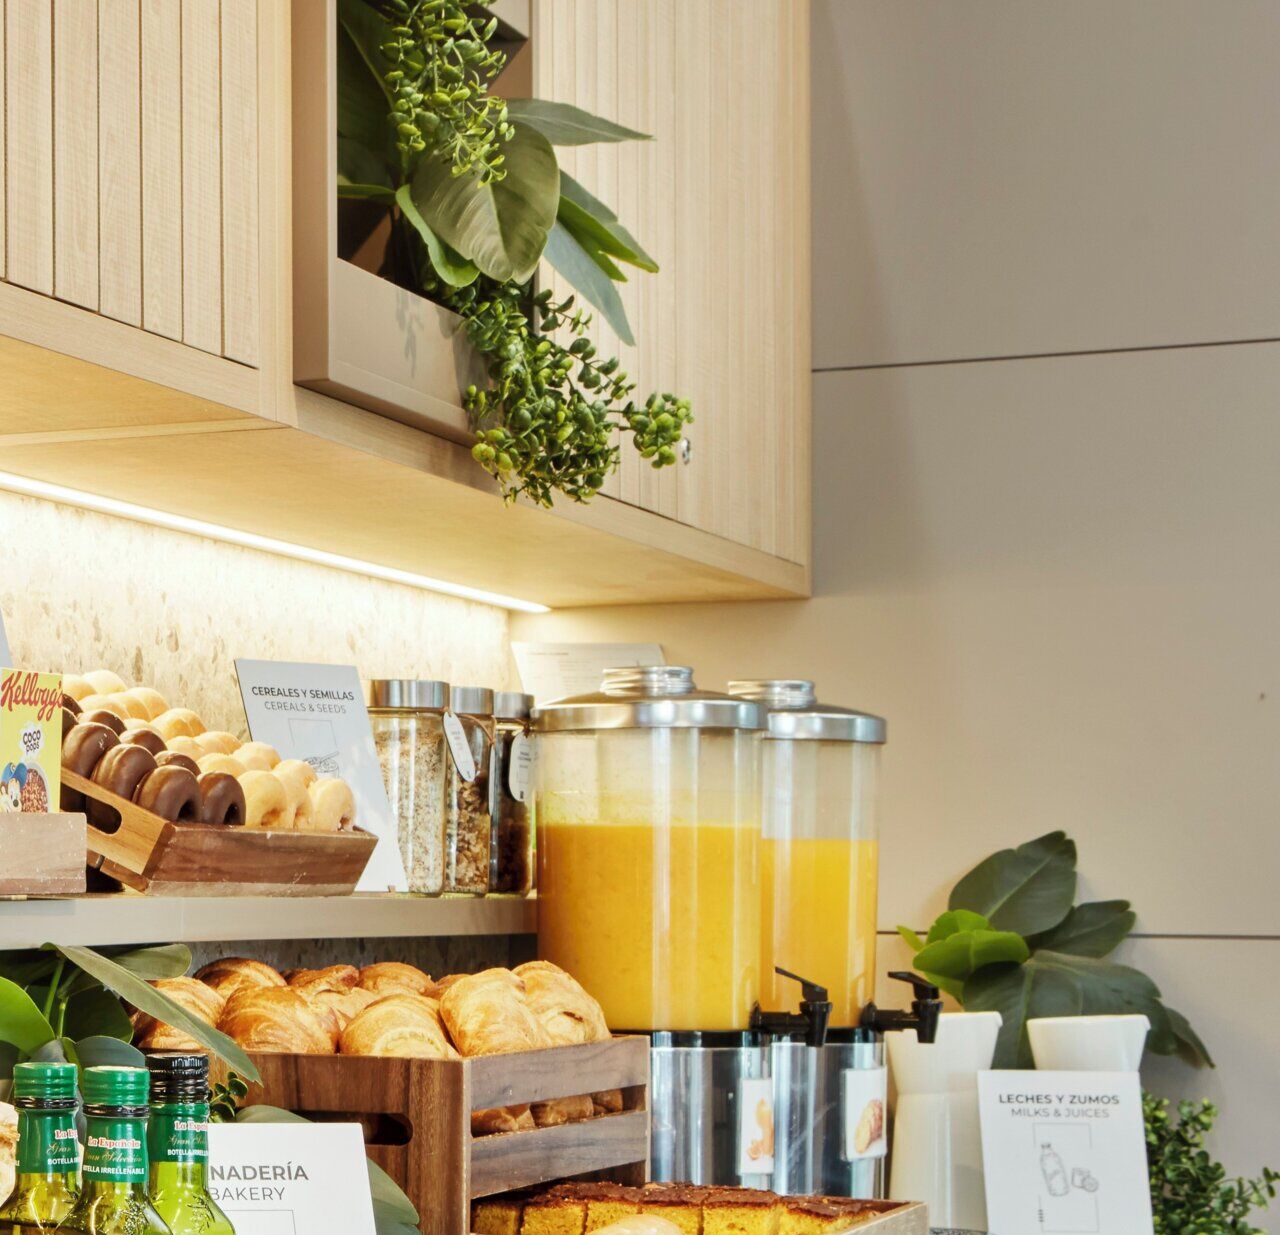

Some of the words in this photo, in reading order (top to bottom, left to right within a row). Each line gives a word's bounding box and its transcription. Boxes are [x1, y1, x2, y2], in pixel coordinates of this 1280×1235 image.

[0, 671, 64, 722] Kellogg's
[251, 686, 300, 698] CEREALES
[301, 689, 307, 698] Y
[309, 690, 355, 701] SEMILLAS
[264, 701, 307, 712] CEREALS
[308, 703, 315, 712] &
[316, 704, 347, 714] SEEDS
[998, 1093, 1053, 1104] LECHES
[1055, 1094, 1065, 1104] Y
[1069, 1094, 1120, 1105] ZUMOS
[1011, 1107, 1050, 1118] MILKS
[1053, 1108, 1062, 1118] &
[1065, 1108, 1110, 1118] JUICES
[210, 1161, 309, 1181] NADERÍA
